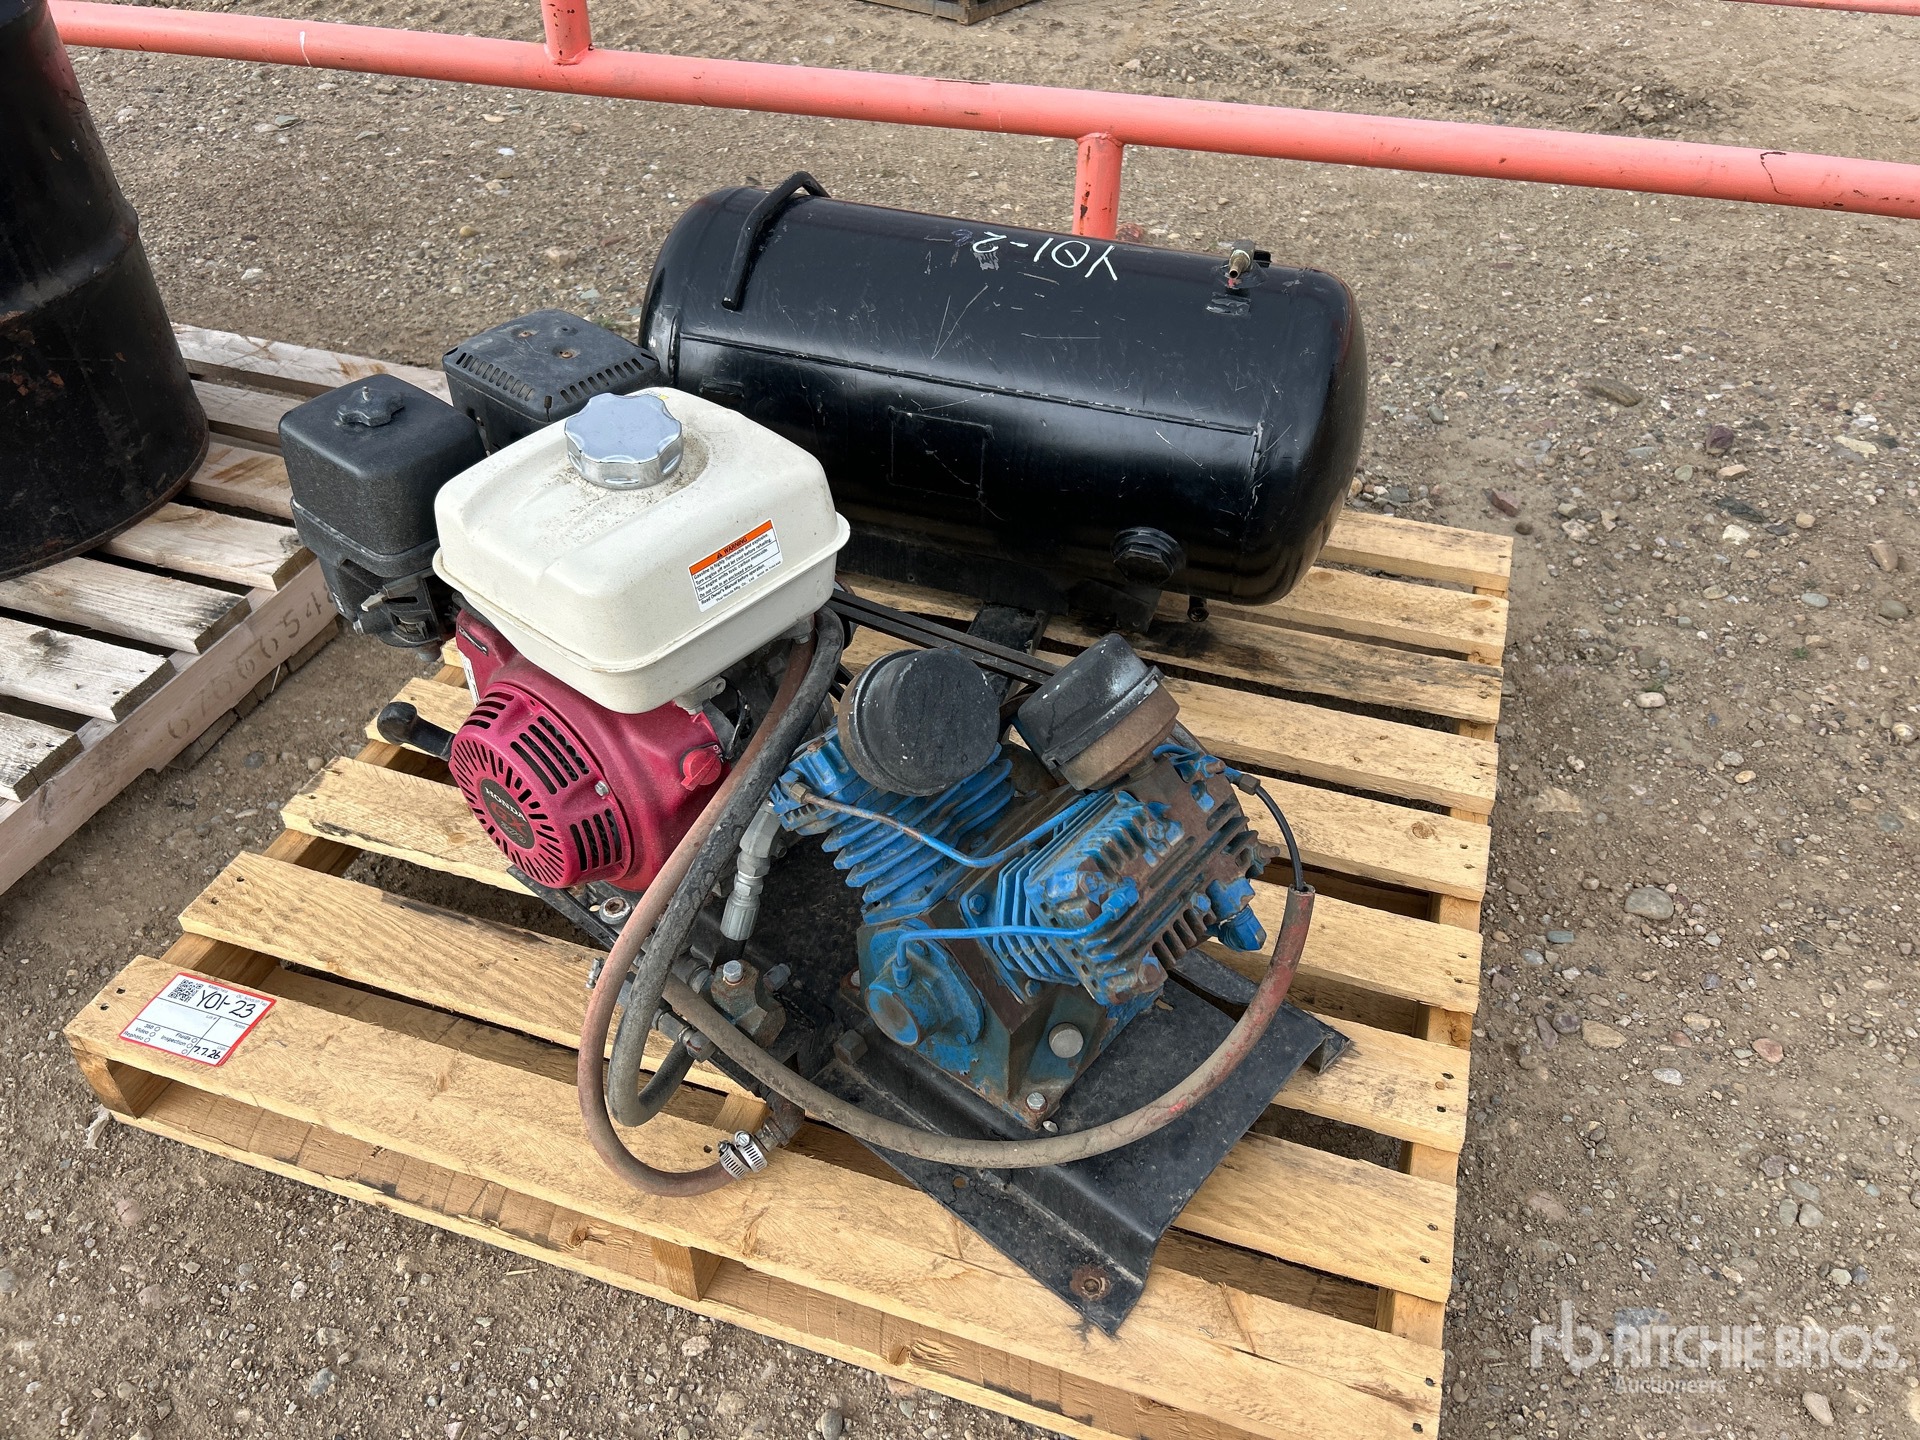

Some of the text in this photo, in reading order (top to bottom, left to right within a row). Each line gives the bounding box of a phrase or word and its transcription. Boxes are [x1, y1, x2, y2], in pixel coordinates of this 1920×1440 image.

[724, 537, 747, 554] WARNING
[484, 786, 527, 823] HONDA
[490, 801, 528, 837] GX
[160, 1034, 187, 1046] Inspection
